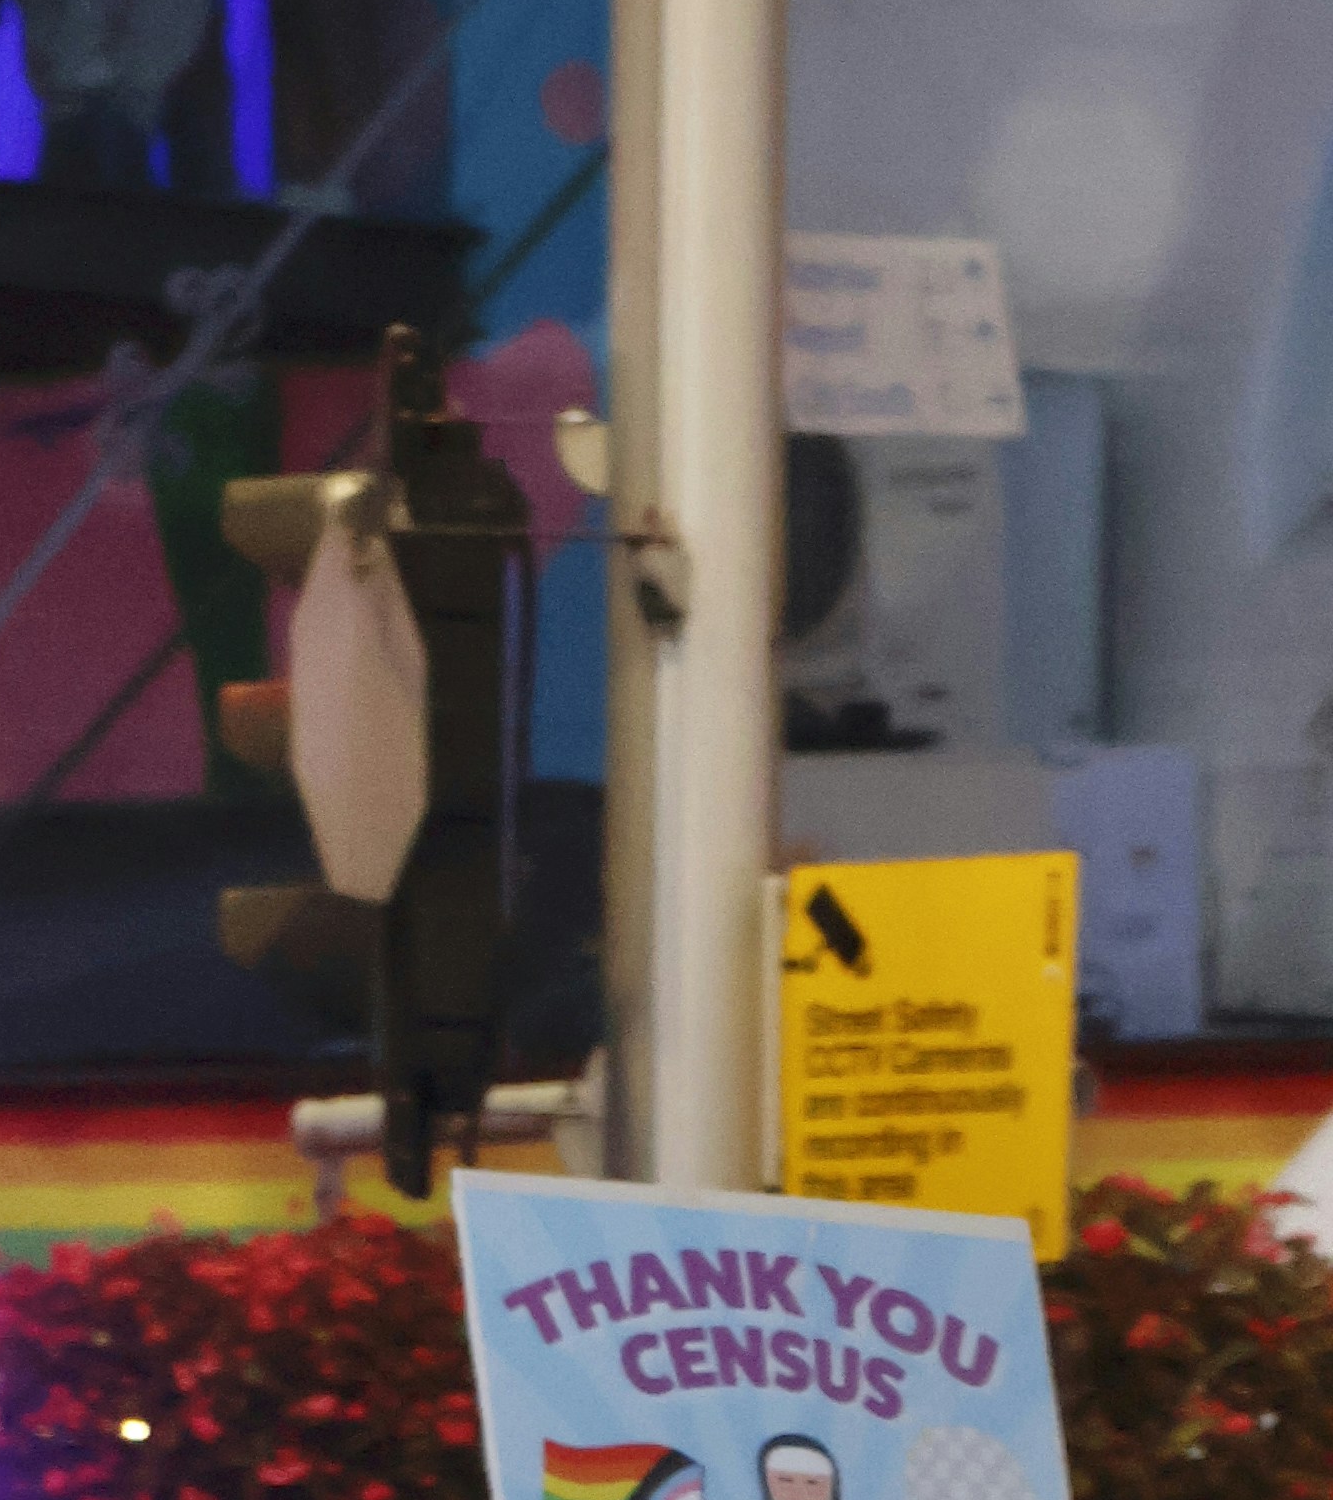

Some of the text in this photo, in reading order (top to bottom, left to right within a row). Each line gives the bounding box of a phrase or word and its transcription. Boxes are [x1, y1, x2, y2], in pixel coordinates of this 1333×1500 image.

[503, 1248, 999, 1388] THANK YOU
[619, 1325, 906, 1420] CENSUS
